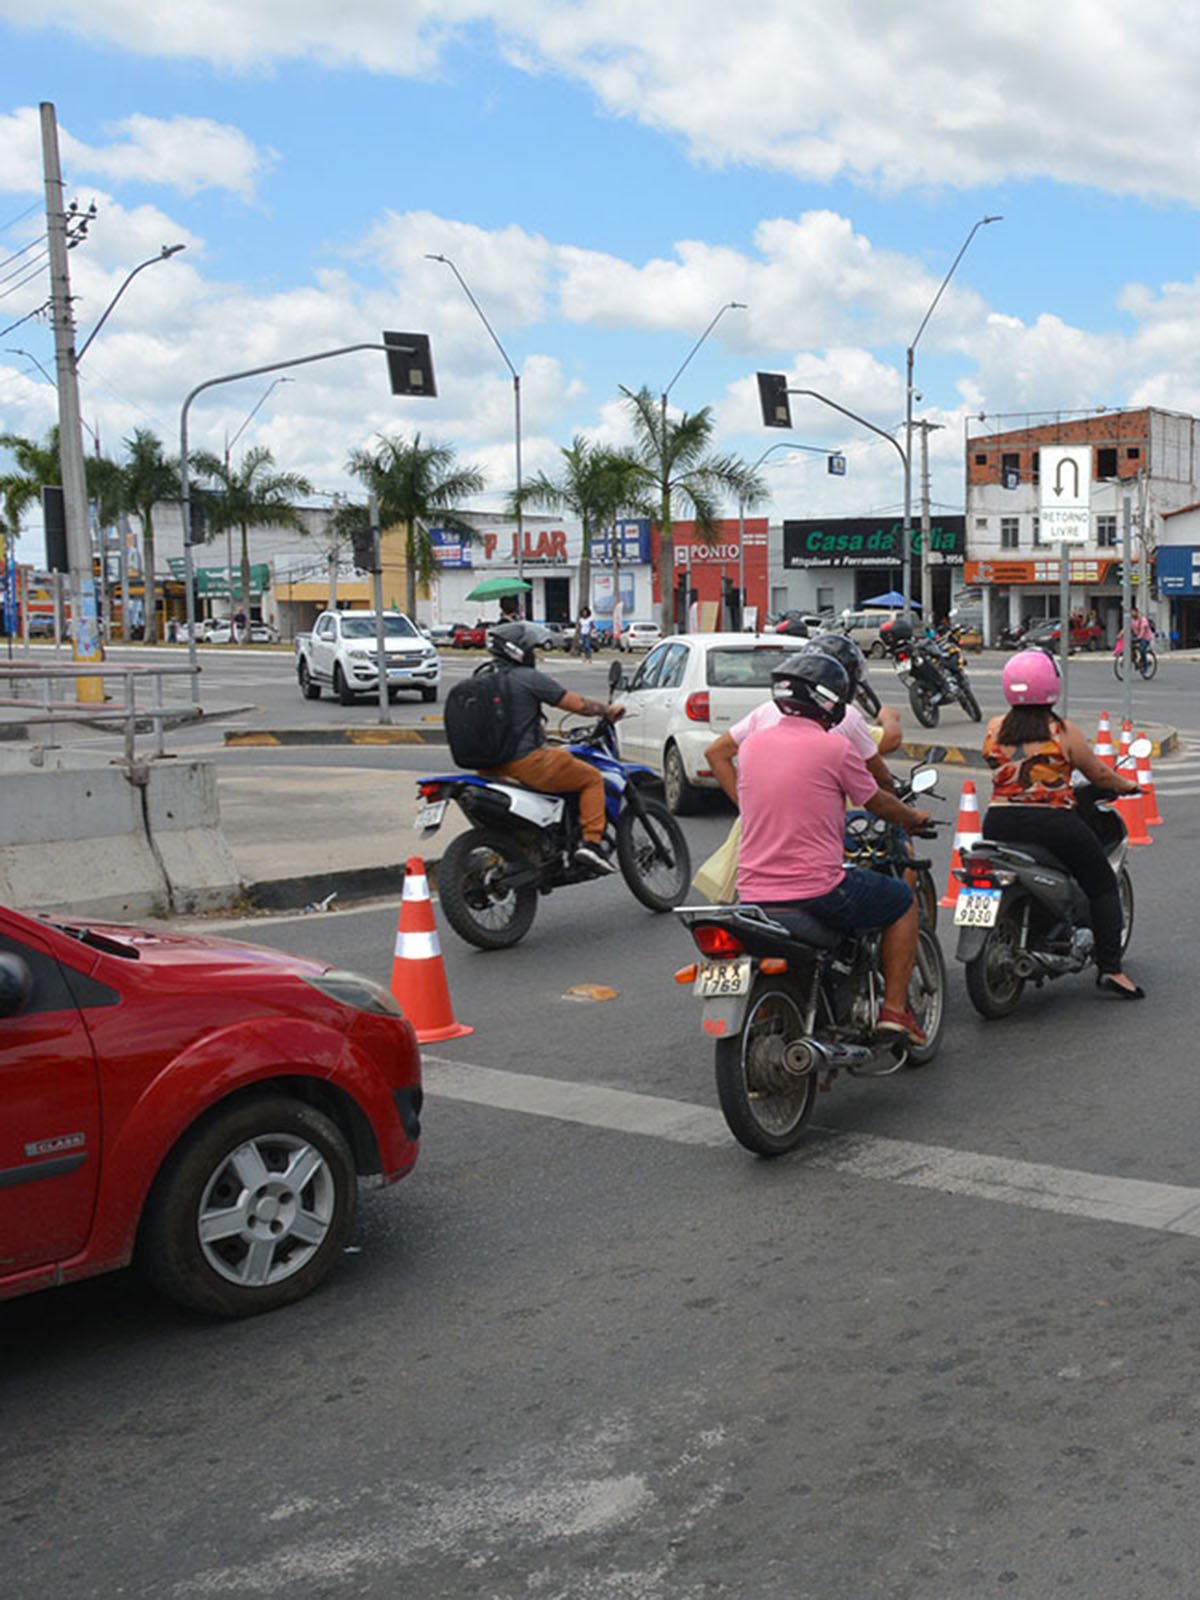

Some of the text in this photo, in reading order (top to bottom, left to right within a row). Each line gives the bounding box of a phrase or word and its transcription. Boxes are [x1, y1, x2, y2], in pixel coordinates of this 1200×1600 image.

[1041, 511, 1088, 523] RETORNO
[1050, 526, 1079, 537] LIVRE
[806, 531, 863, 550] Casa
[867, 530, 896, 550] da
[690, 545, 740, 559] PONTO
[704, 966, 741, 981] JRX
[702, 980, 741, 993] 1769
